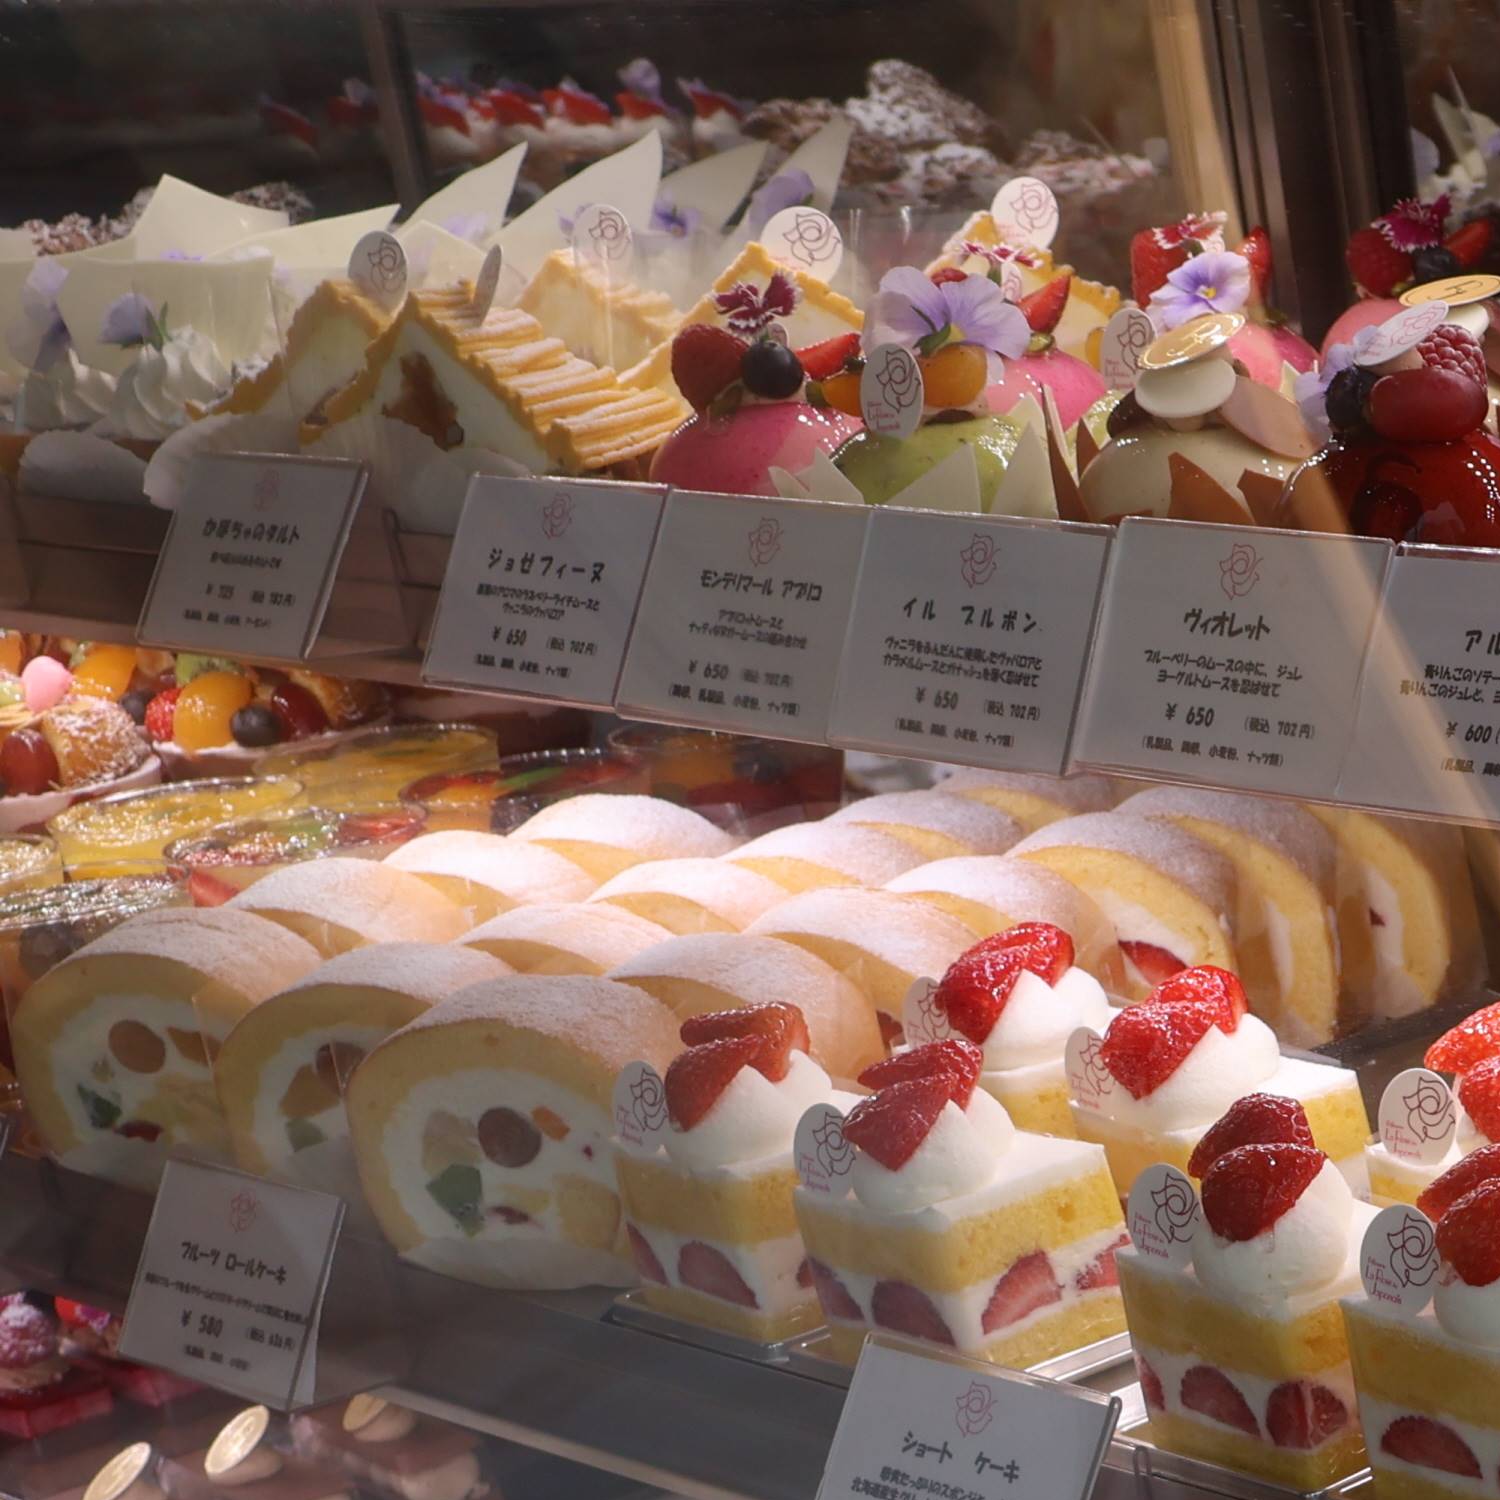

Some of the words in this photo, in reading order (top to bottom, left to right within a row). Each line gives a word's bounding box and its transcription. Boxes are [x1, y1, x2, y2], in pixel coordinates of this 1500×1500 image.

[488, 547, 606, 584] ジョゼフィーヌ
[903, 598, 936, 621] イル
[1184, 608, 1271, 640] ヴィオレット
[506, 629, 528, 647] 650
[704, 663, 729, 681] 650
[934, 691, 960, 710] 650
[1166, 703, 1177, 720] ¥
[1186, 707, 1215, 727] 650
[1446, 722, 1458, 738] ¥
[1465, 725, 1492, 743] 600
[198, 1314, 224, 1338] 580
[901, 1431, 953, 1465] ショート
[974, 1452, 1020, 1484] ケーキ
